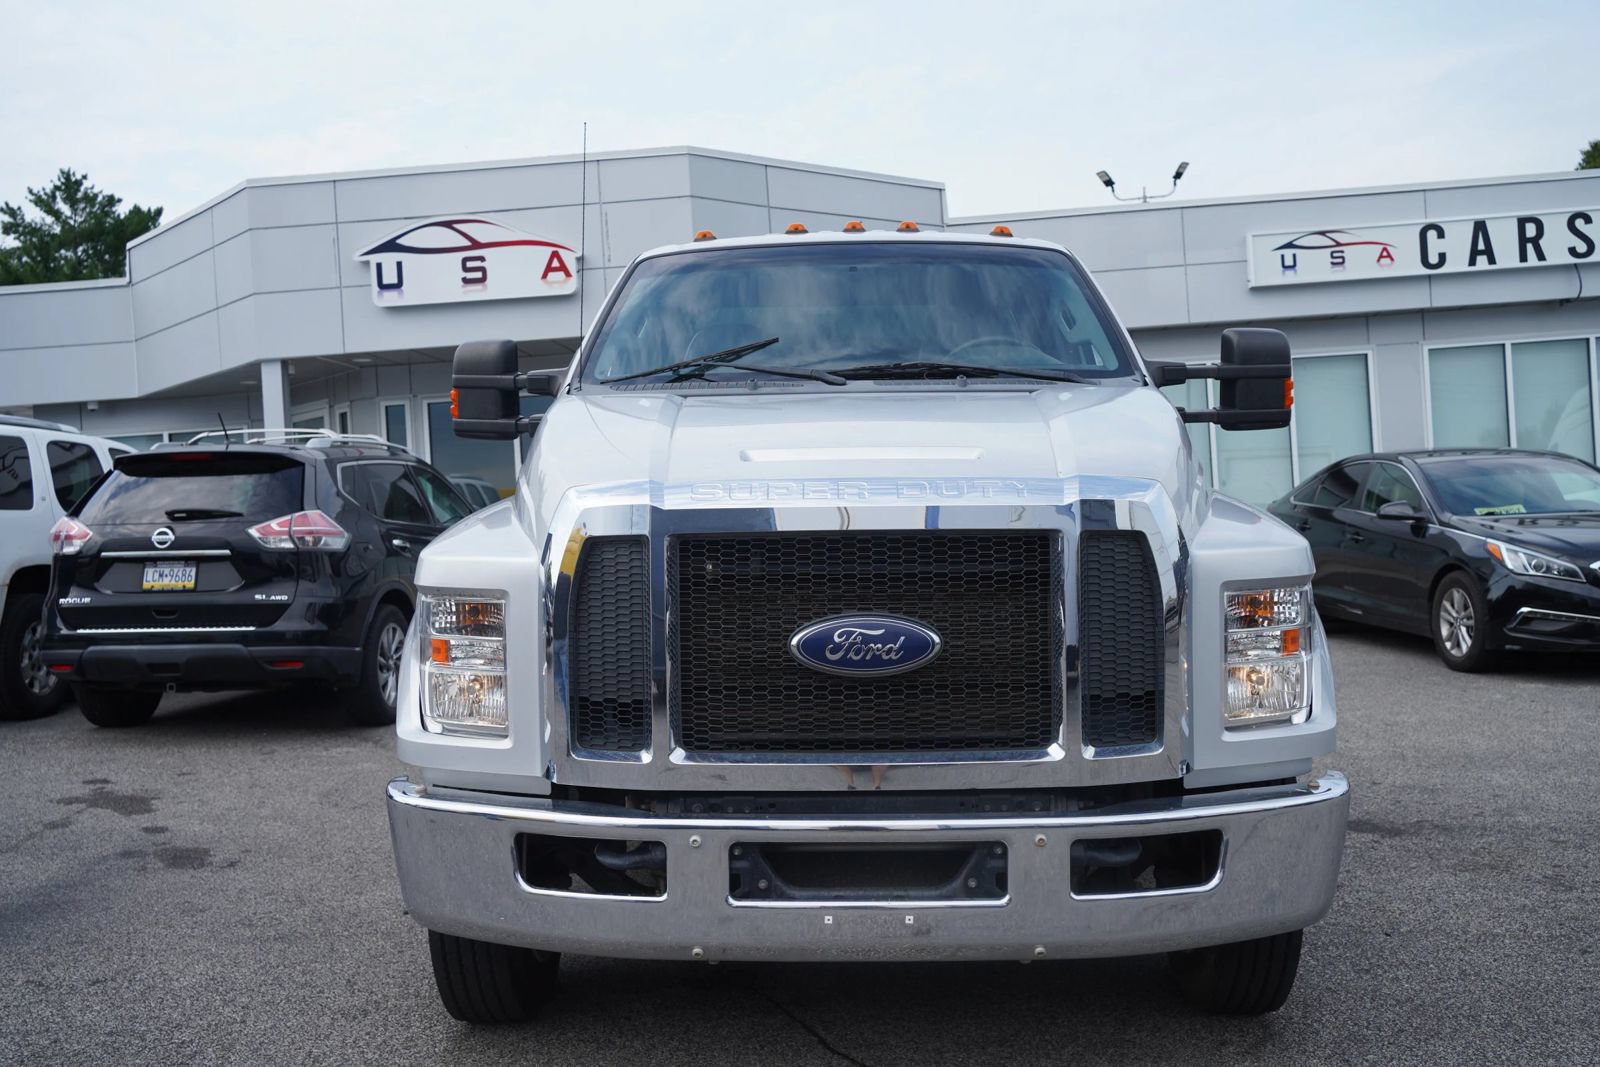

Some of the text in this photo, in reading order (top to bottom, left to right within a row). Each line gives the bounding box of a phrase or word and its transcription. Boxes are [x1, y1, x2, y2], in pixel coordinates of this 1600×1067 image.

[1280, 211, 1596, 270] USA CARS
[375, 250, 573, 290] USA
[690, 480, 1028, 501] SUPER DUTY
[825, 627, 906, 661] Ford
